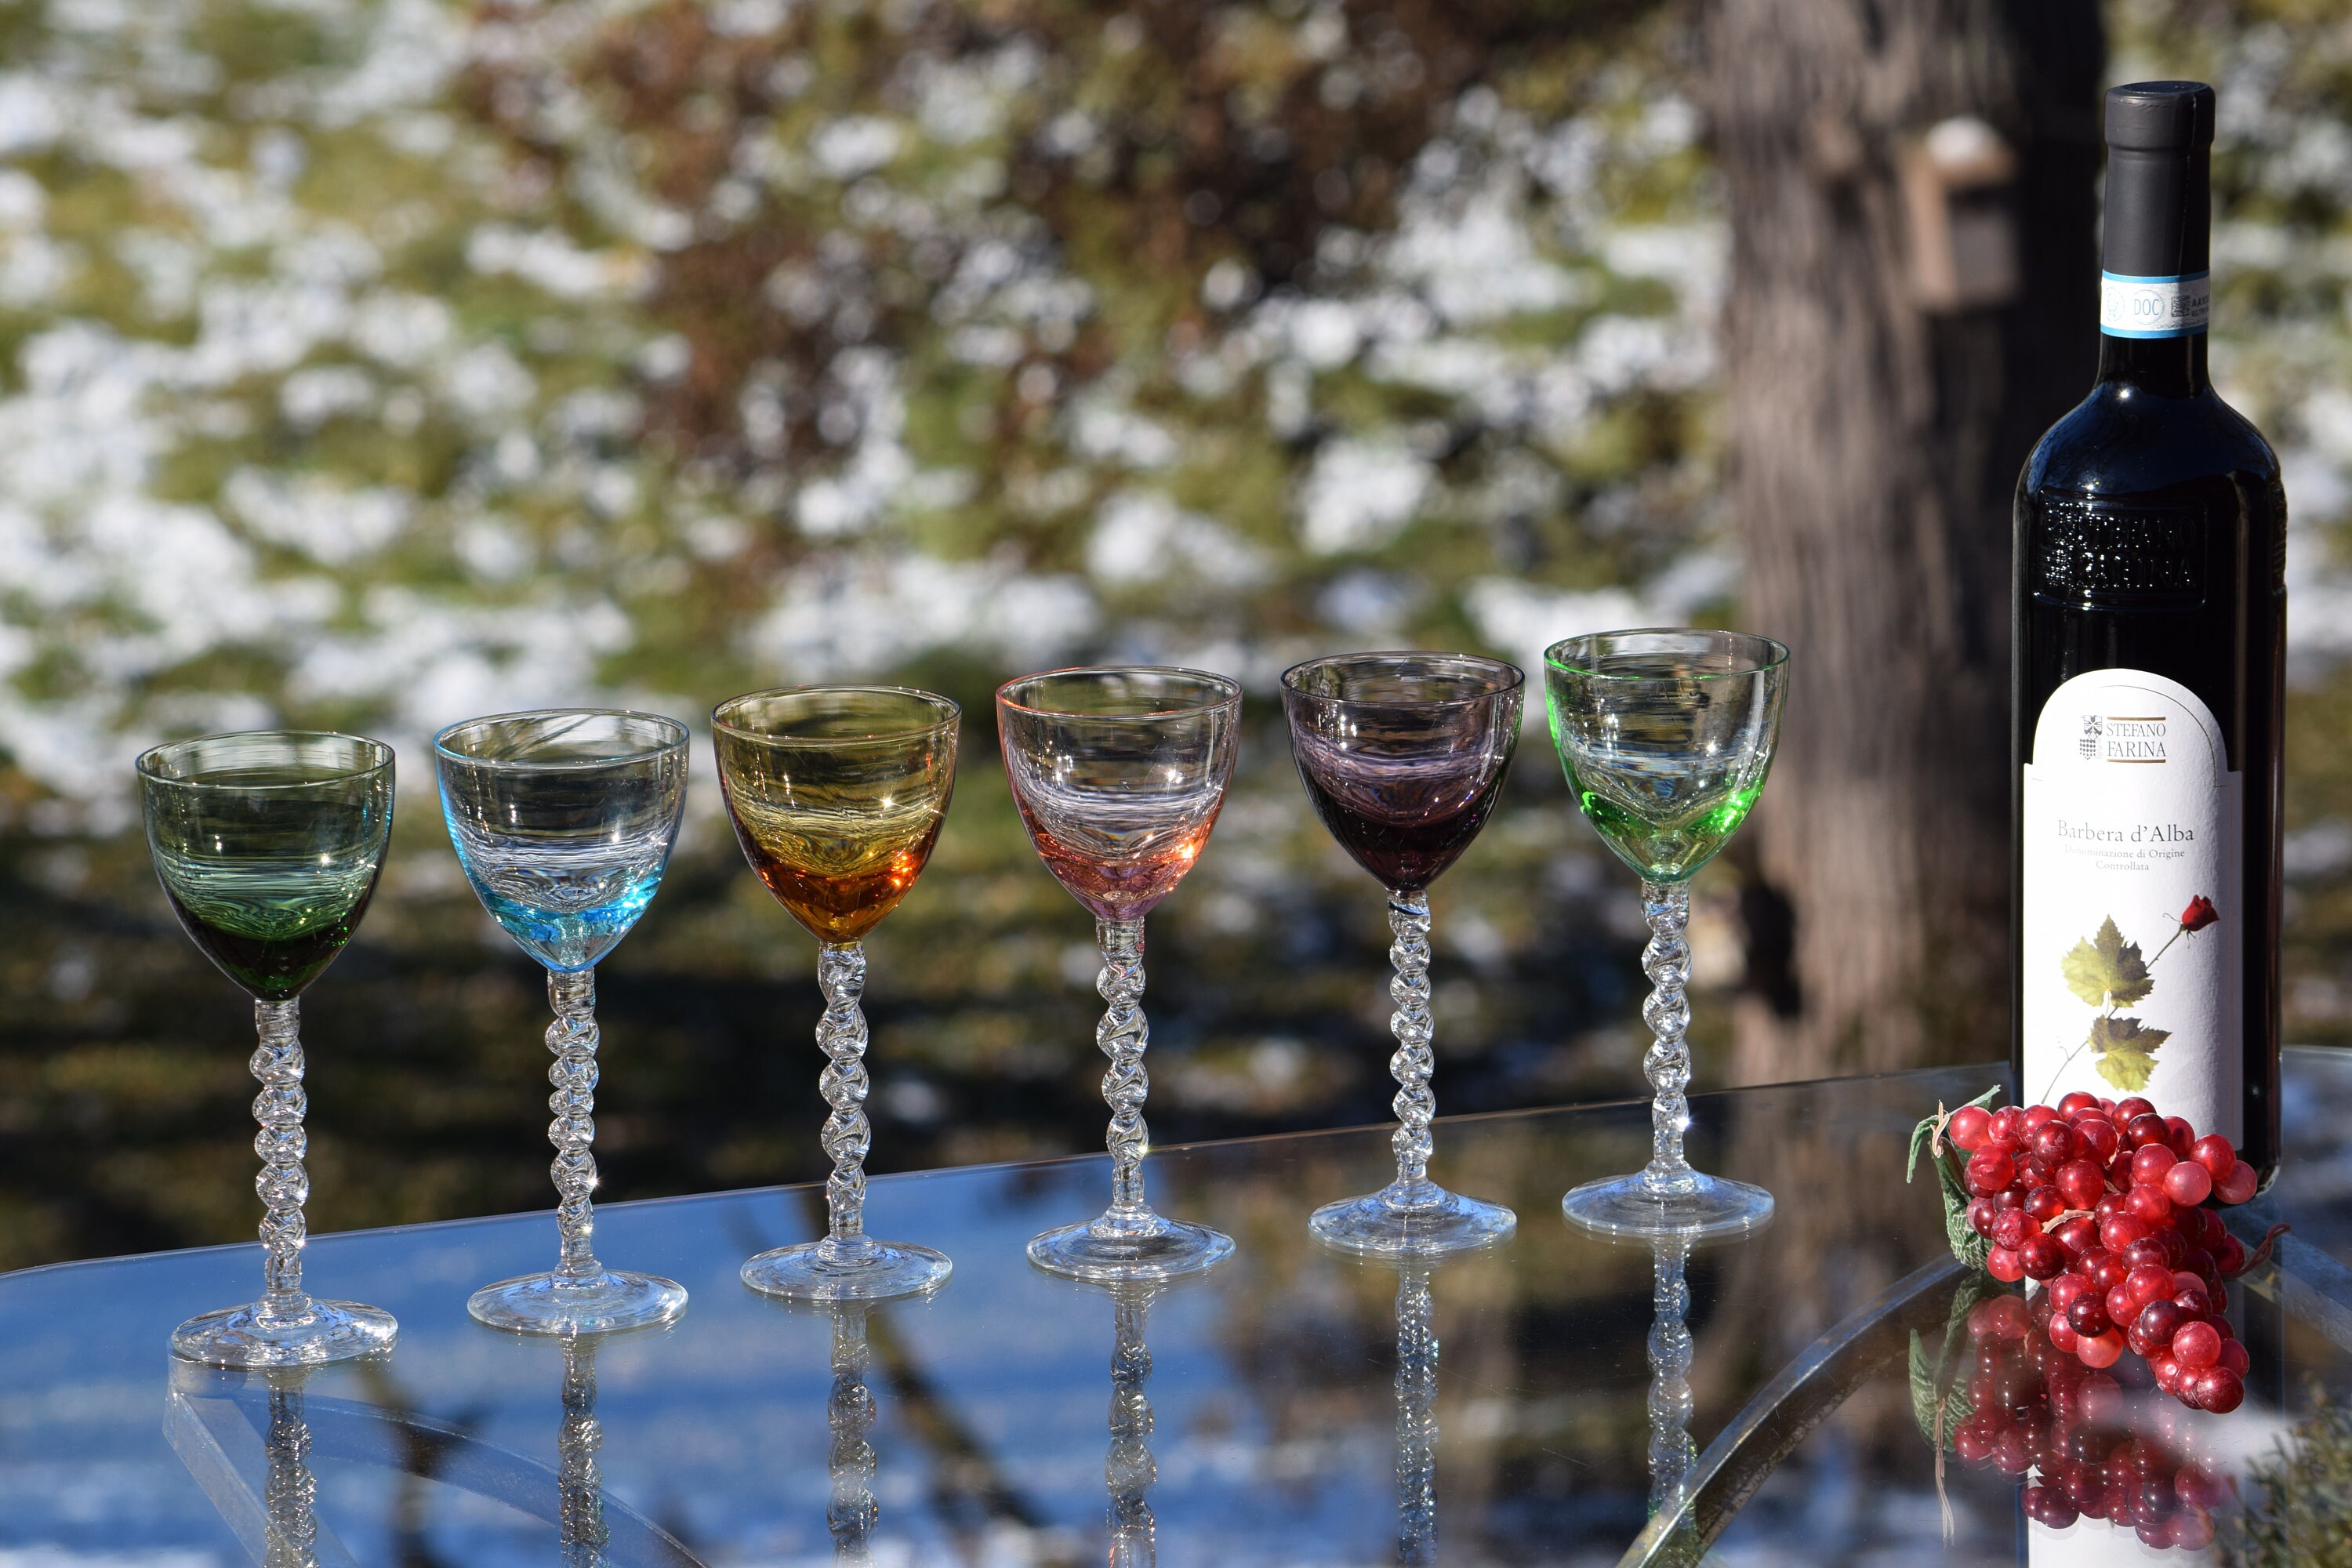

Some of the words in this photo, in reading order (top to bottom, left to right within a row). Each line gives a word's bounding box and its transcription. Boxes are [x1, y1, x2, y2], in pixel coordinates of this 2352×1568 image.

[2134, 298, 2160, 316] DOC
[2106, 723, 2166, 737] STEFANO
[2107, 741, 2166, 757] FARINA
[2058, 819, 2124, 842] Barbera
[2130, 824, 2194, 843] d'Alba
[2136, 849, 2146, 858] di
[2148, 849, 2186, 860] Origine
[2096, 860, 2150, 871] Controllata
